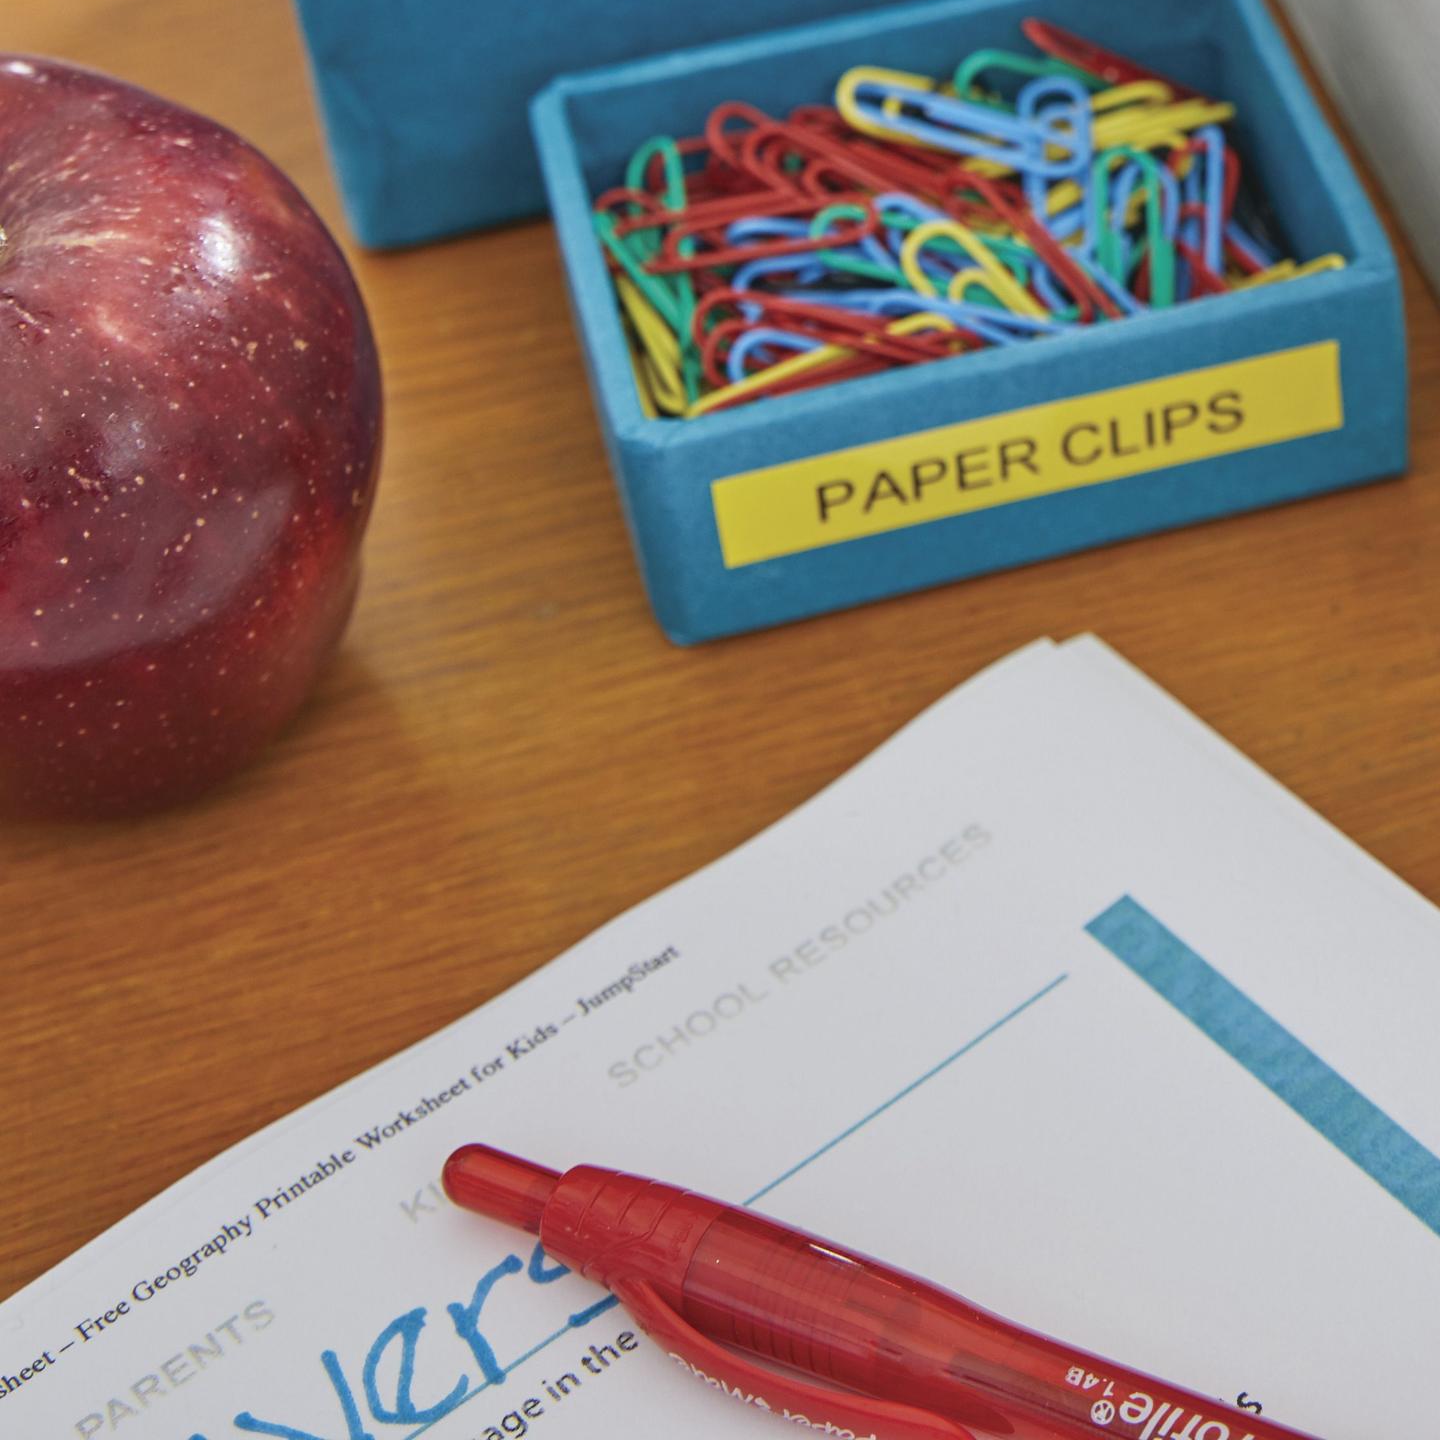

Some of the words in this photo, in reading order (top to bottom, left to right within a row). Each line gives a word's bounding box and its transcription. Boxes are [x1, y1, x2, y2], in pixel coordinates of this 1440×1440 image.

[813, 437, 1039, 524] PAPER
[1060, 389, 1246, 468] CLIPS
[607, 981, 769, 1088] SCHOOL
[768, 822, 993, 984] RESOURCES
[74, 1301, 130, 1342] Free
[132, 1215, 252, 1302] Geography
[254, 1147, 356, 1219] Printable
[353, 1077, 471, 1151] Worksheet
[471, 1058, 507, 1085] for
[506, 1020, 560, 1063] Kids
[575, 945, 679, 1017] JumpStart
[74, 1299, 276, 1440] PARENTS
[469, 1394, 544, 1440] age
[542, 1371, 581, 1402] in
[581, 1329, 640, 1376] the
[1065, 1365, 1114, 1396] 1.4B
